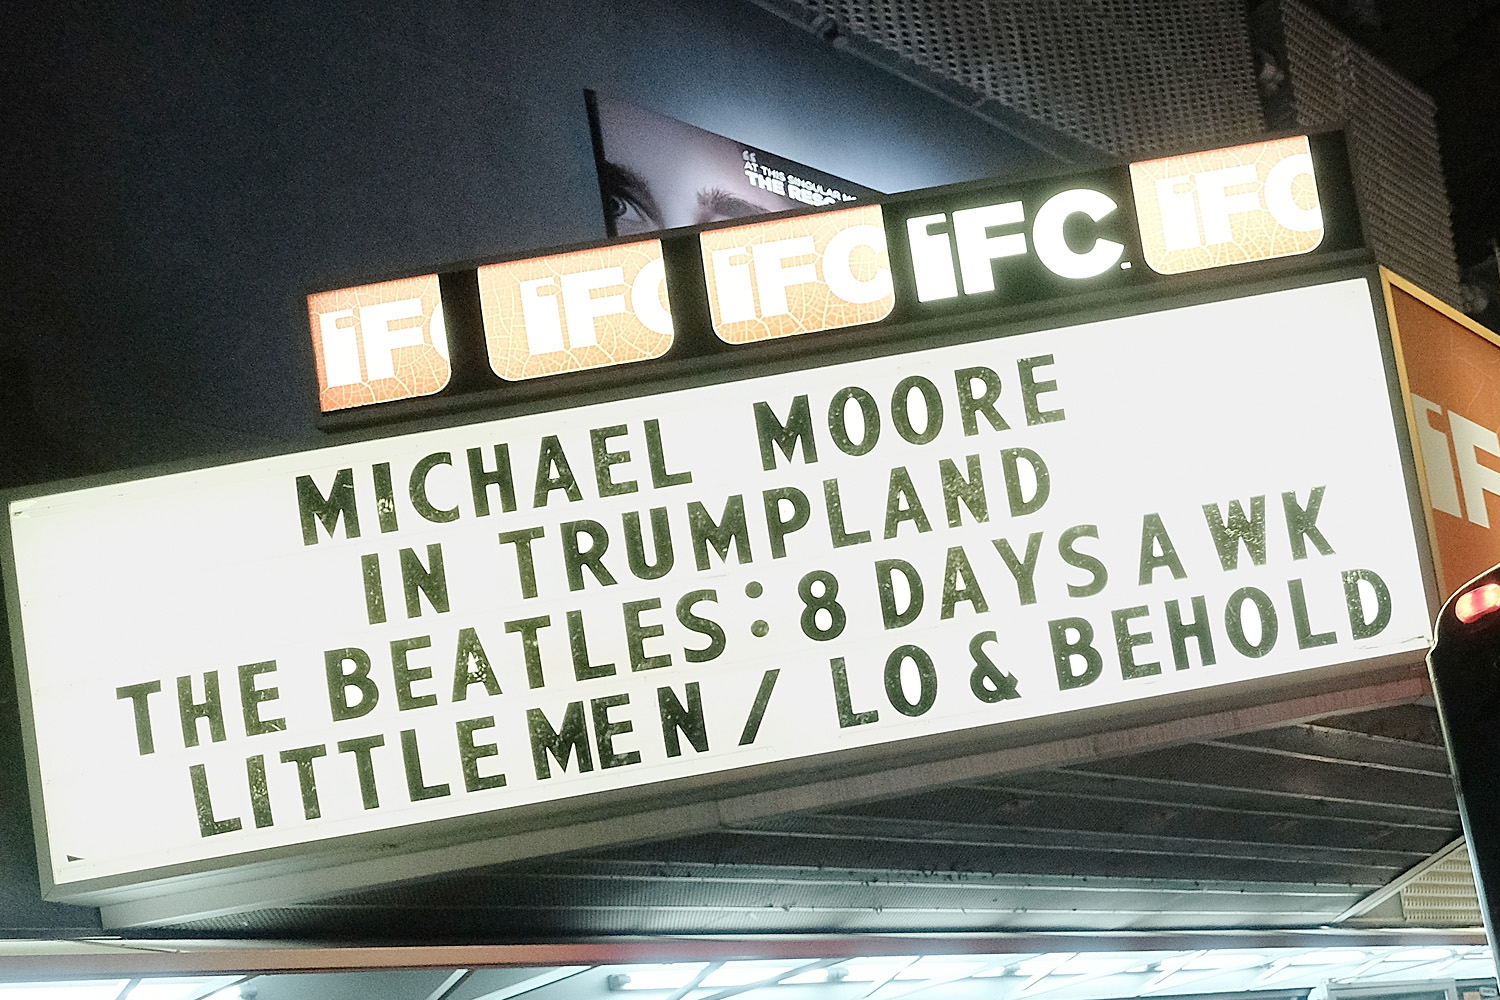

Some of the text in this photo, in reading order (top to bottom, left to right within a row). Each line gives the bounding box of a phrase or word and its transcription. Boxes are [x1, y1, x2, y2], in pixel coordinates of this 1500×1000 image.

[744, 161, 758, 172] AT
[760, 165, 786, 182] THIS
[787, 174, 842, 201] SINGULAR
[744, 169, 786, 196] THE
[296, 354, 1066, 545] MICHAEL MOORE
[361, 448, 1050, 624] IN TRUMPLAND
[116, 660, 286, 755] THE
[875, 526, 1107, 629] DAYS
[1139, 514, 1186, 584] A
[1203, 488, 1335, 570] WK
[190, 570, 1391, 837] LITTLE MEN / LO & BEHOLD
